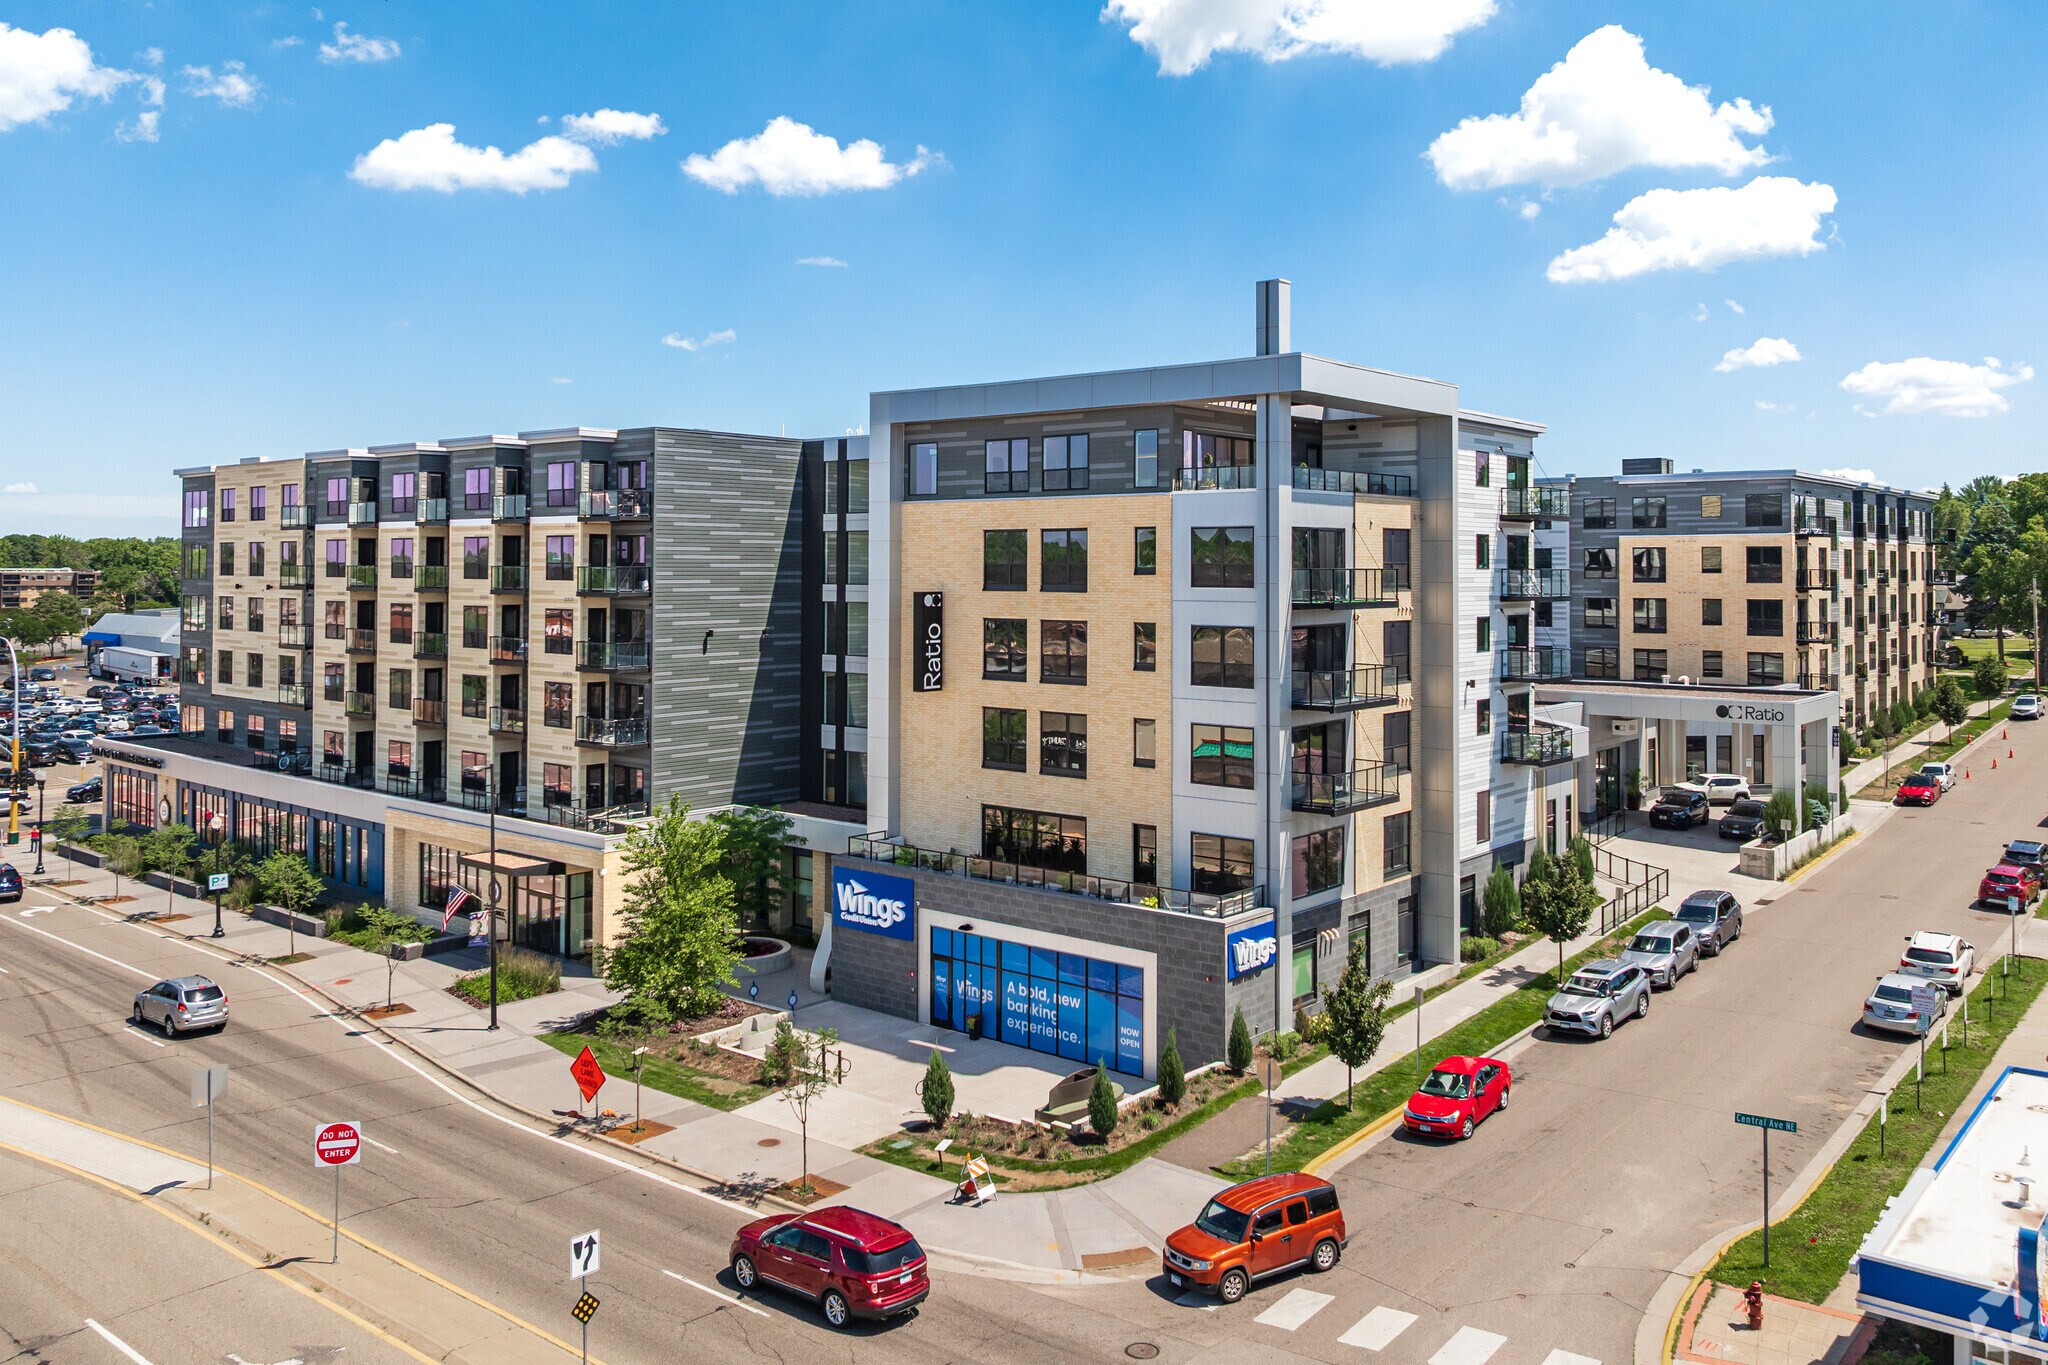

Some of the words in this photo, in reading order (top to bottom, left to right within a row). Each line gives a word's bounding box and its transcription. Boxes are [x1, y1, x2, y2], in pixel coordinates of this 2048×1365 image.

[923, 623, 941, 690] Ratio
[1745, 705, 1785, 722] Ratio
[836, 879, 906, 929] Wings
[1232, 937, 1277, 965] Wings
[956, 979, 993, 1004] Wings
[1007, 981, 1016, 994] A
[1018, 982, 1051, 1004] bold,
[1053, 993, 1081, 1009] new
[1912, 993, 1934, 1001] PARKING
[1007, 998, 1058, 1026] banking
[1007, 1017, 1081, 1045] experience.
[1120, 1026, 1140, 1038] NOW
[1120, 1037, 1140, 1049] OPEN
[580, 1059, 594, 1069] LEFT
[580, 1068, 595, 1079] LANE
[577, 1076, 599, 1089] CLOSED
[1736, 1113, 1767, 1127] Central
[1768, 1119, 1784, 1129] Ave
[1785, 1121, 1796, 1131] NE
[322, 1131, 335, 1140] DO
[338, 1130, 354, 1139] NOT
[324, 1148, 351, 1158] ENTER
